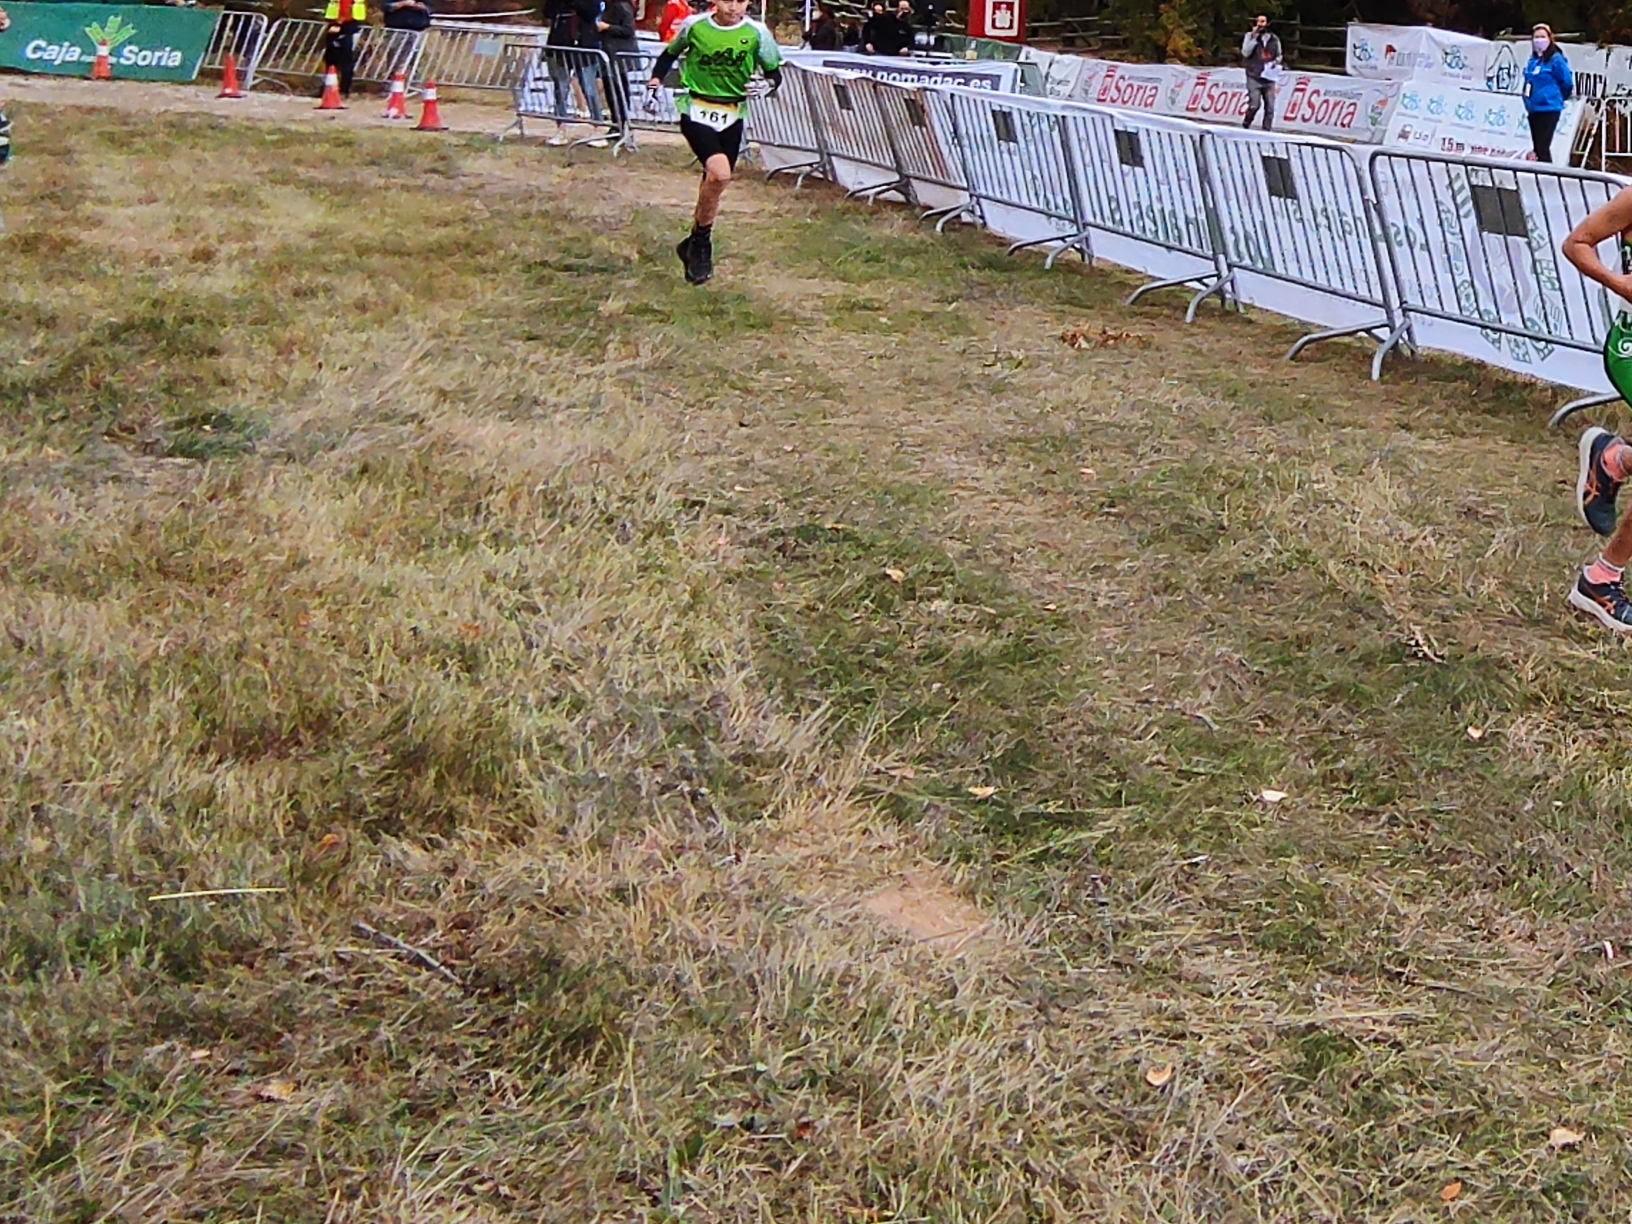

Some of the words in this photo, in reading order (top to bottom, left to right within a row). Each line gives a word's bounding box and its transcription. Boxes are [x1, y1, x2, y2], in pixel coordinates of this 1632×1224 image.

[26, 40, 81, 64] Caja
[119, 46, 182, 66] Soria
[1110, 74, 1159, 108] Soria
[1201, 83, 1249, 116] Soria
[1301, 87, 1357, 128] Soria
